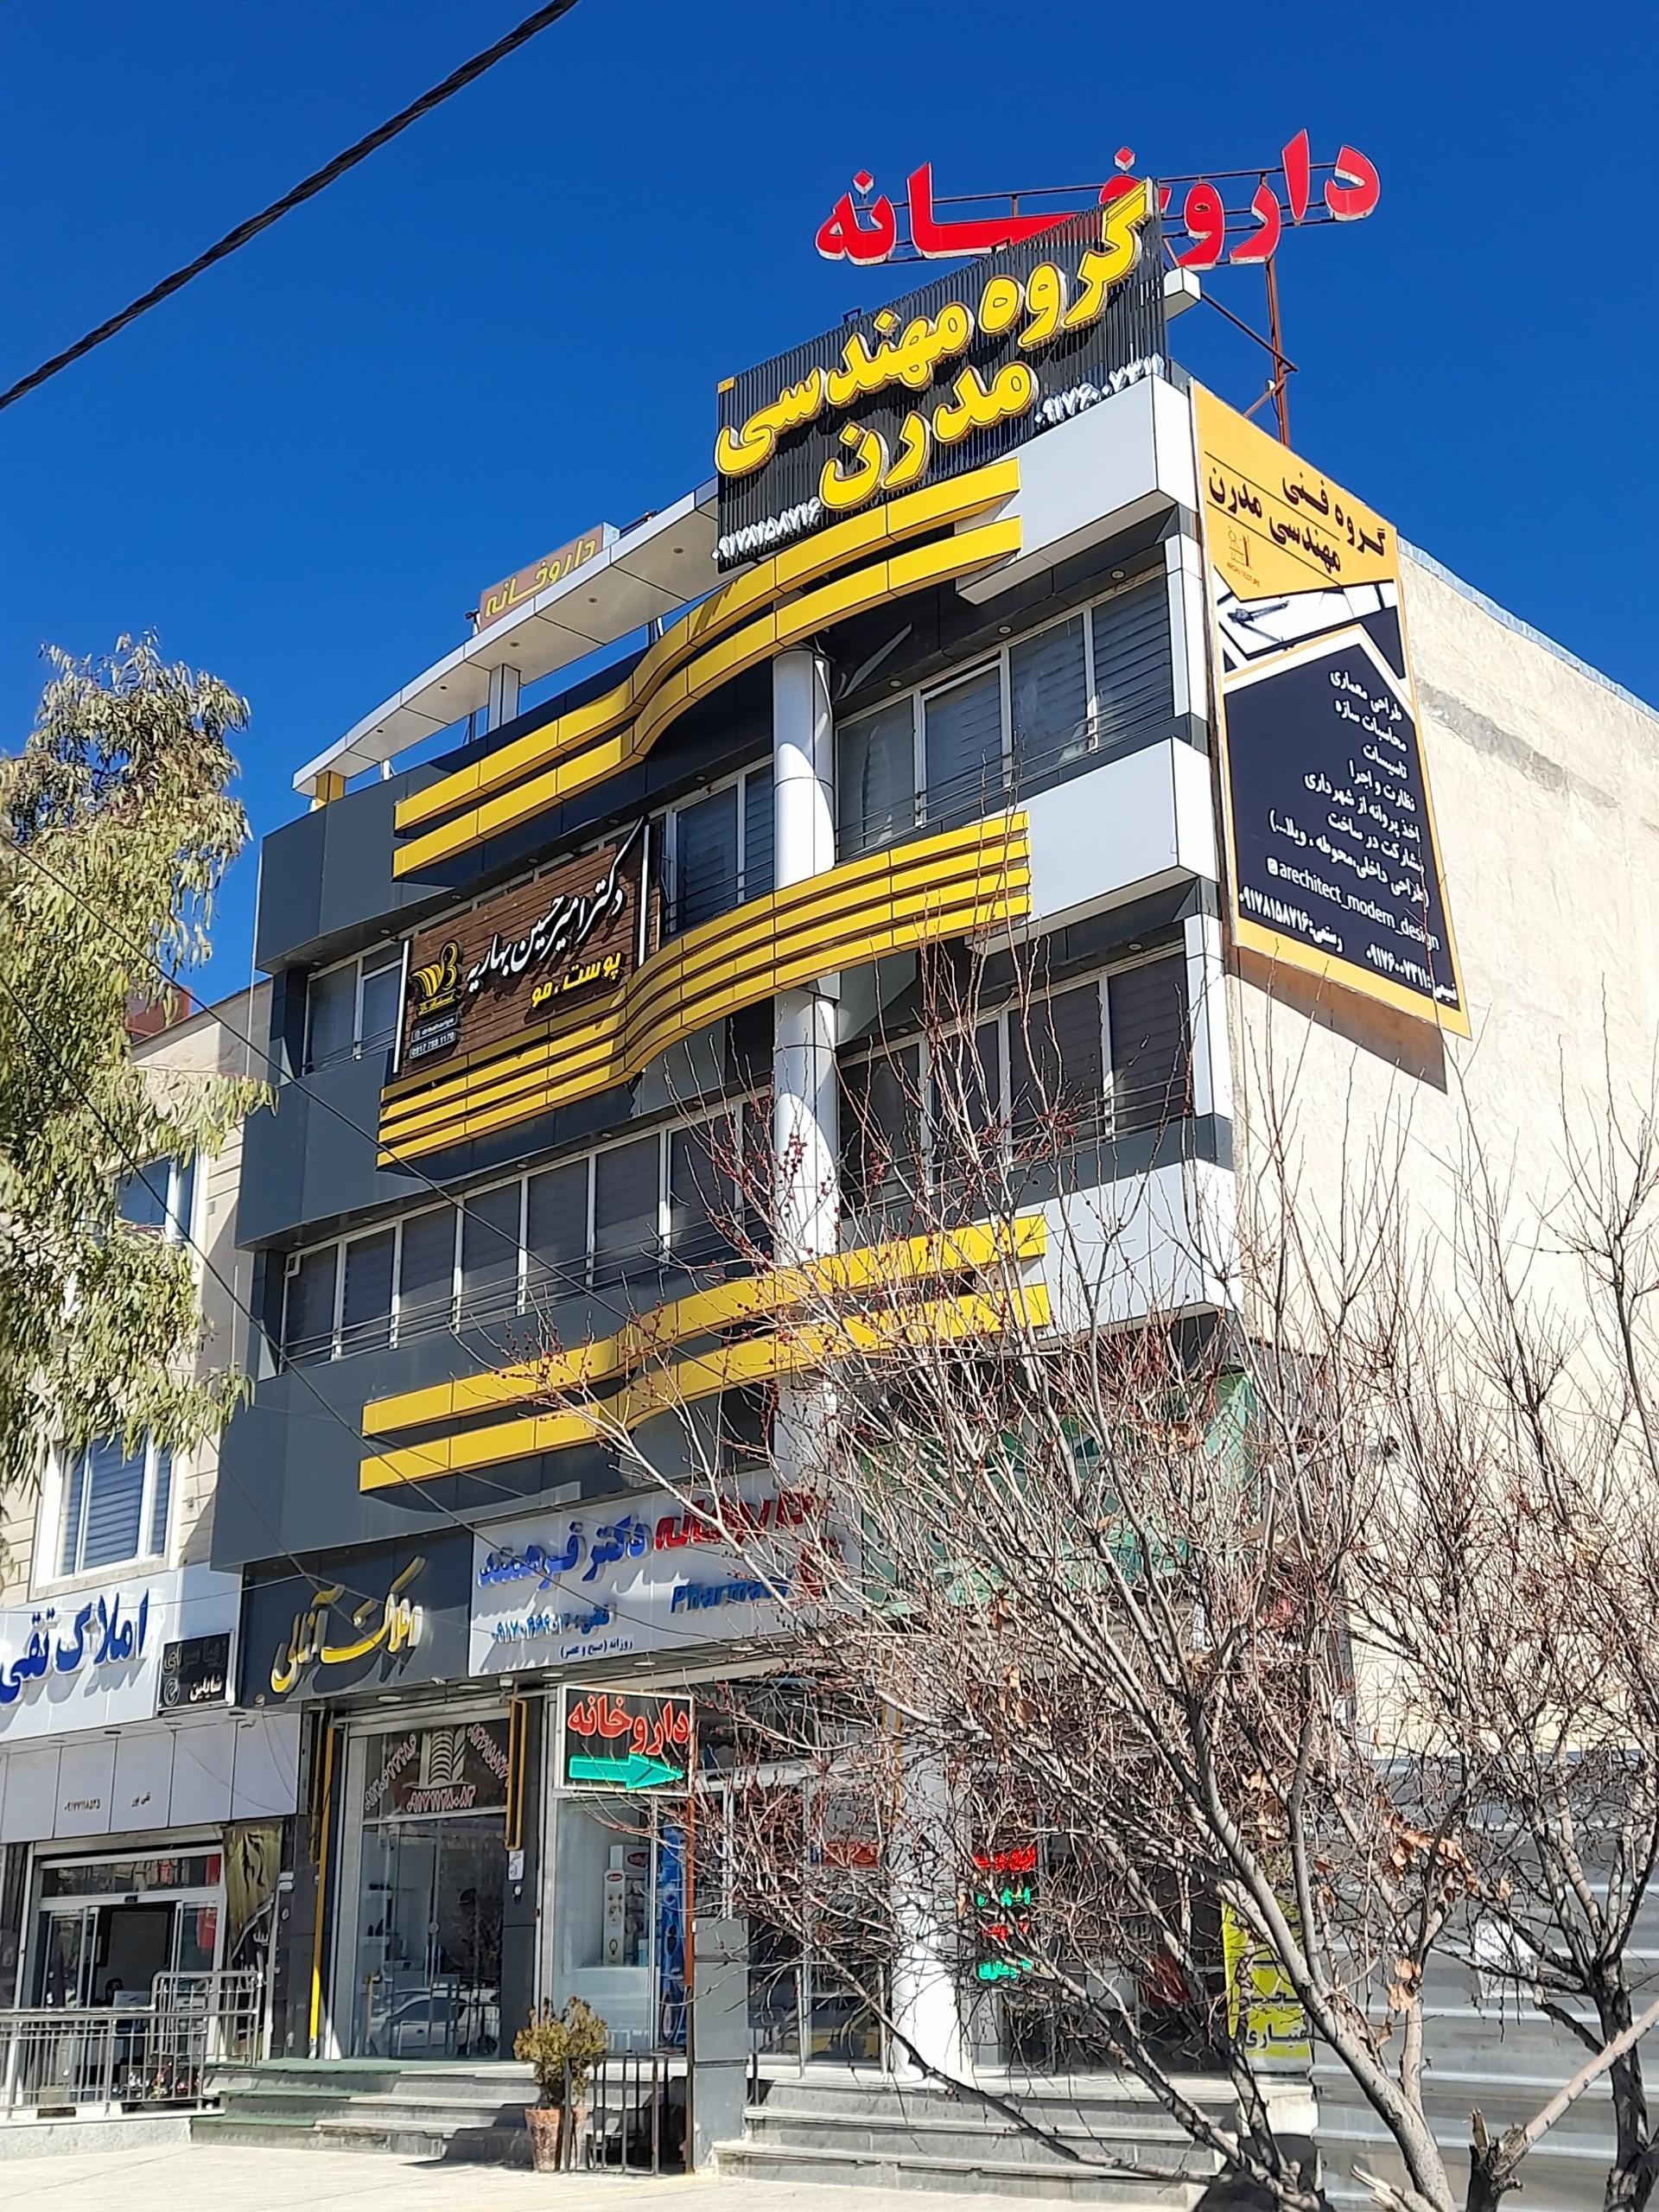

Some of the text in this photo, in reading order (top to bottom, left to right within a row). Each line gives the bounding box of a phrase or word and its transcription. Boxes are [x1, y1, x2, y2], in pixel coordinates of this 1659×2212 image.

[815, 129, 1380, 269] داروخانه
[714, 177, 1154, 478] گروه مهندسی
[817, 359, 1039, 512] مدرن
[1209, 467, 1341, 575] مهندسی مدرن
[1282, 473, 1386, 557] گروه فنی
[484, 538, 596, 618] داروخانه
[1331, 671, 1402, 721] طراحی معماری
[1335, 700, 1408, 752] محاسبات سازه
[1349, 760, 1416, 811] نظارت و اجرا
[1363, 744, 1408, 779] تاسیسات
[1328, 813, 1363, 840] ساخت
[1357, 796, 1367, 814] از
[1402, 819, 1421, 843] اخذ
[1365, 836, 1379, 849] در
[576, 816, 644, 944] دکتر
[531, 982, 553, 1008] مو
[582, 1515, 649, 1582] دکتر
[55, 1588, 149, 1673] املاک
[609, 1637, 633, 1651] روزانه
[568, 1694, 690, 1756] داروخانه
